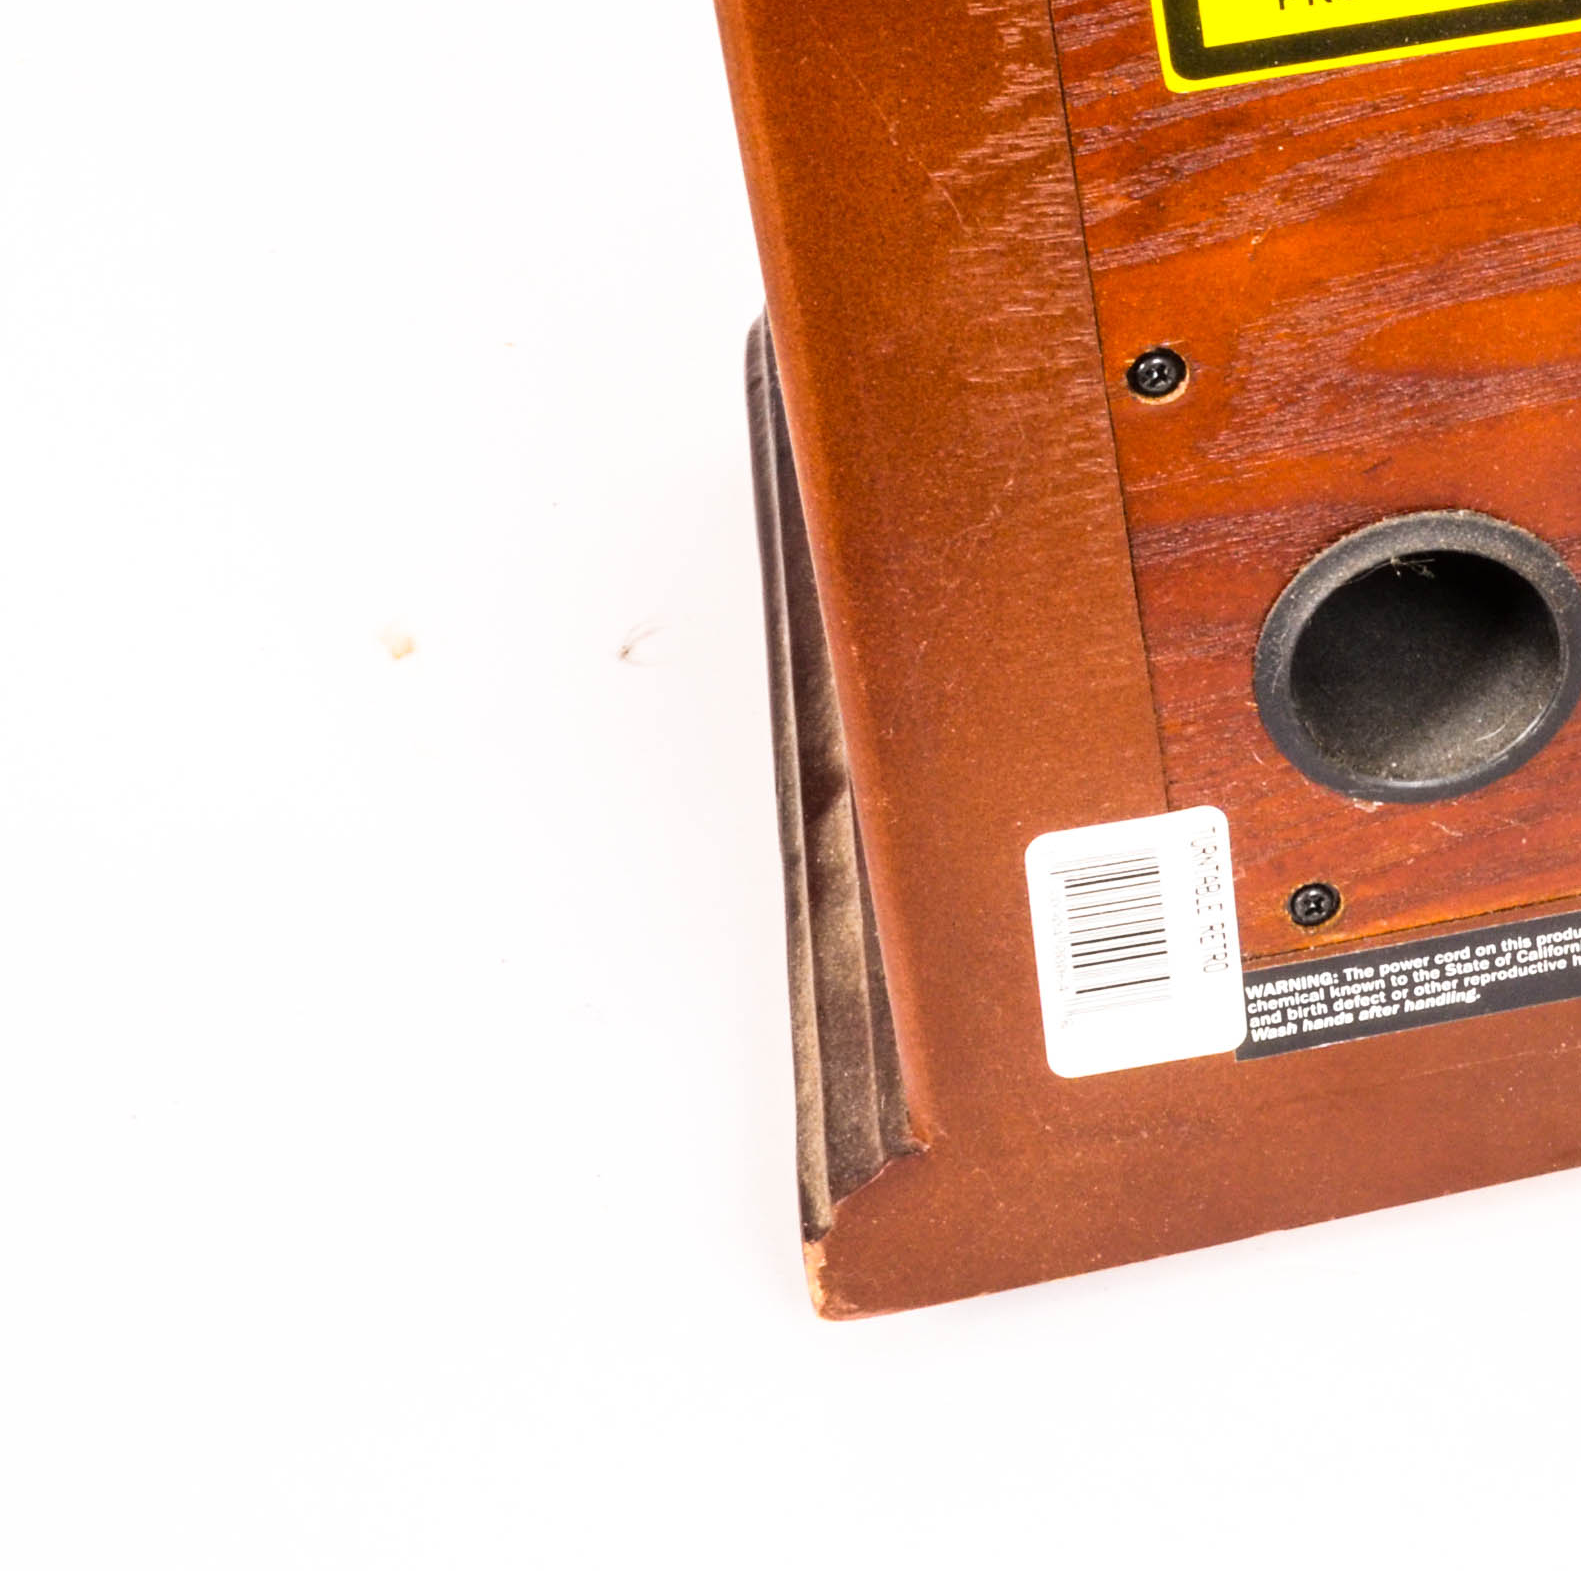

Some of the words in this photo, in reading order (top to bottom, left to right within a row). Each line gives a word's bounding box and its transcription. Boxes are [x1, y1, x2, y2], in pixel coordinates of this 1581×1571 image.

[1246, 971, 1340, 1000] WARNING:
[1342, 966, 1375, 982] The
[1378, 955, 1430, 978] power
[1433, 945, 1471, 968] cord
[1474, 943, 1497, 958] on
[1500, 935, 1533, 953] this
[1247, 988, 1325, 1015] chemical
[1329, 978, 1386, 999] known
[1389, 974, 1409, 988] to
[1412, 968, 1441, 983] the
[1444, 958, 1491, 977] State
[1494, 952, 1512, 968] of
